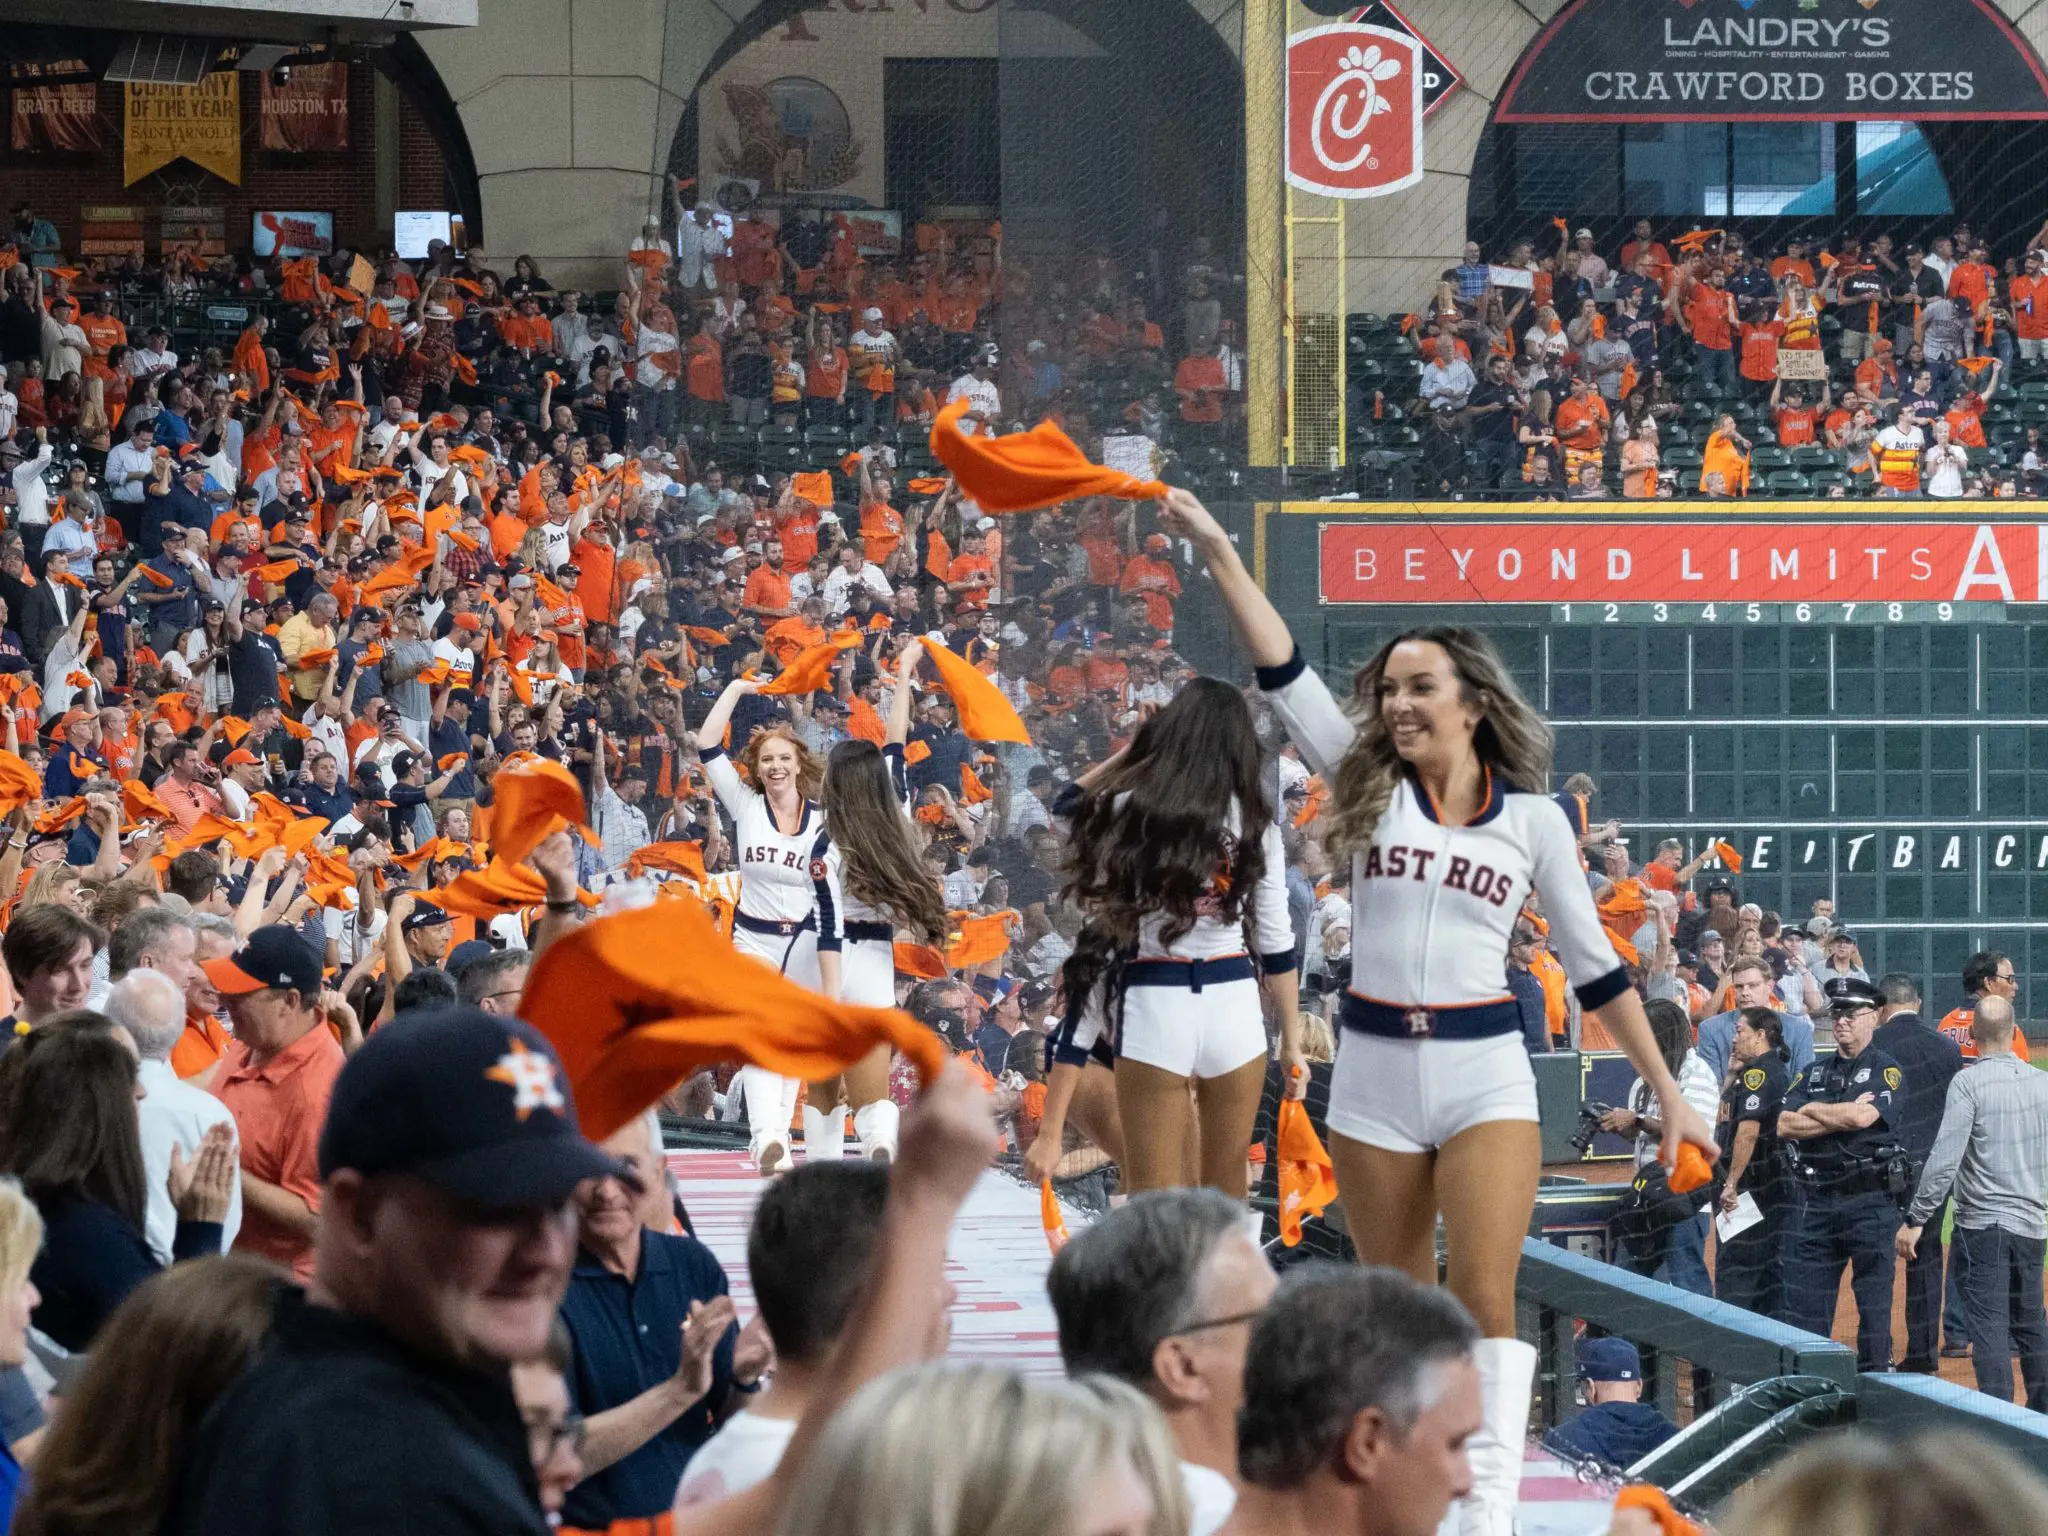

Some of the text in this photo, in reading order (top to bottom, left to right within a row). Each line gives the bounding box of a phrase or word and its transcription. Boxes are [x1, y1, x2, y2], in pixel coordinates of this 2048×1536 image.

[1664, 18, 1890, 47] LANDRY'S
[1770, 51, 1846, 59] ENTERTAINMENT
[1585, 72, 1975, 101] CRAWFORD BOXES
[17, 99, 96, 114] CRAFT BEER
[131, 100, 233, 118] OF THE YEAR
[262, 99, 347, 116] HOUSTON, TX
[1853, 281, 1880, 290] Astros
[1355, 548, 1931, 581] BEYOND LIMITS
[1560, 602, 1953, 622] 1 2 3 4 5 6 7 8 9
